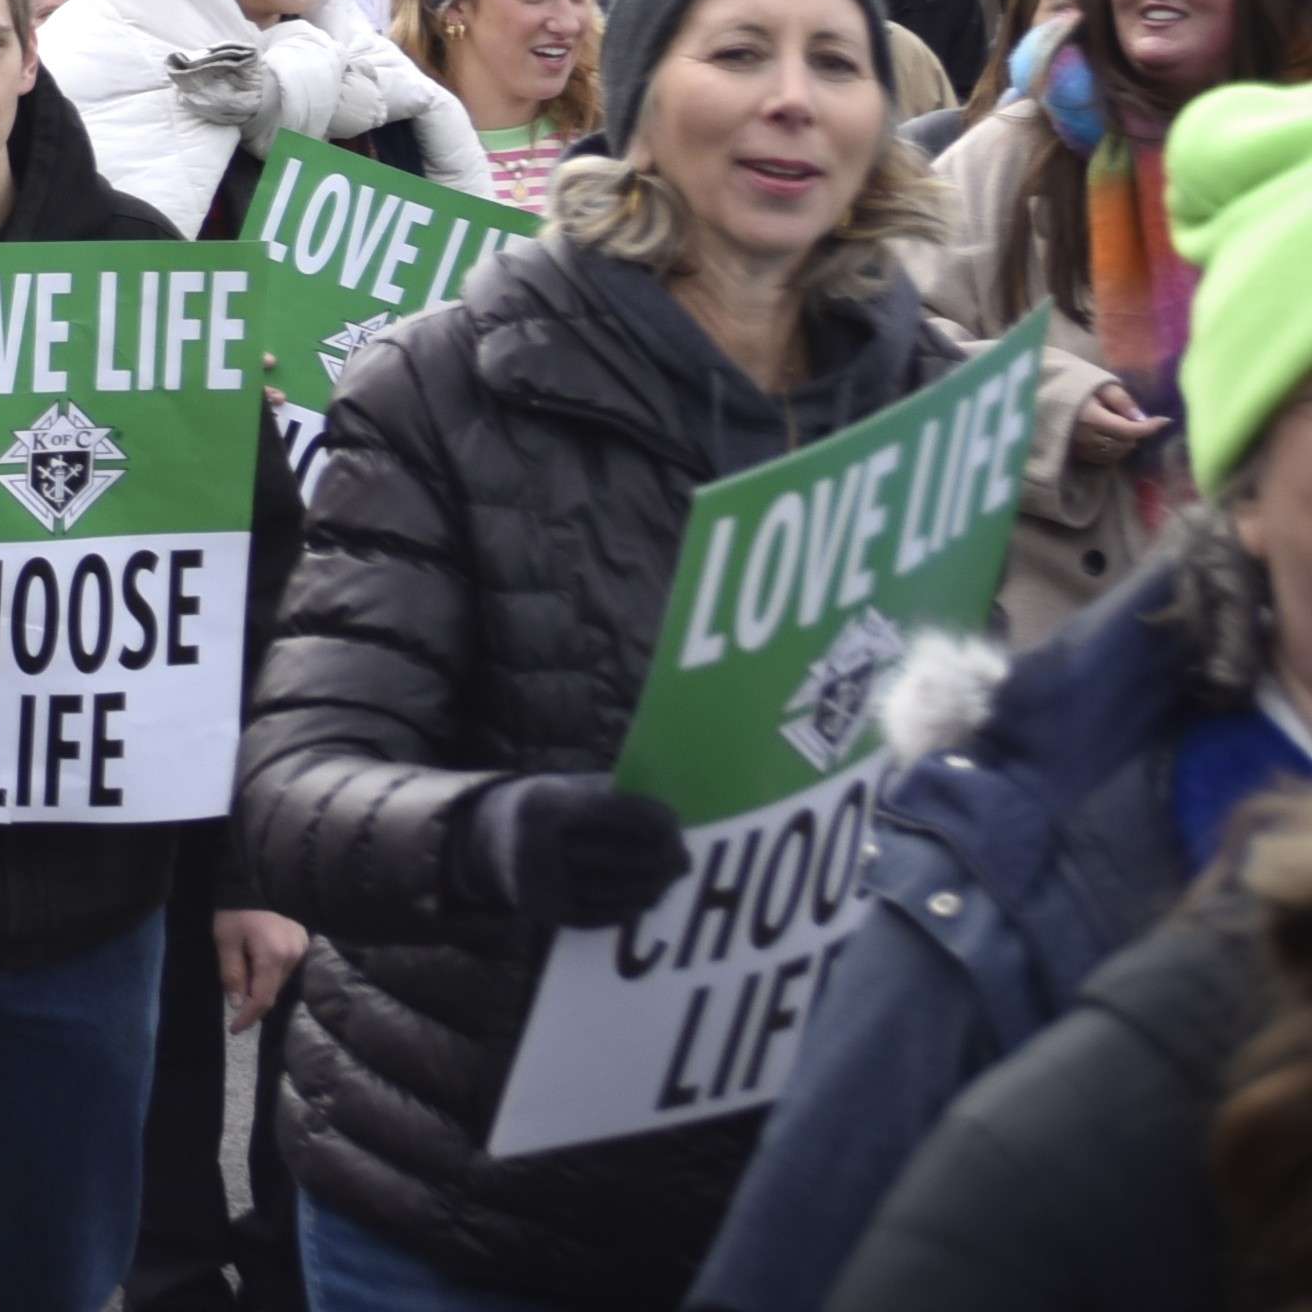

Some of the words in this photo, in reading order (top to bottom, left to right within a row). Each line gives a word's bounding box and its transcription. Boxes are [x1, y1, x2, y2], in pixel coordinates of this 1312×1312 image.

[260, 157, 434, 305] LOVE
[96, 271, 248, 391] LIFE
[33, 432, 49, 450] K
[75, 431, 92, 449] C
[680, 442, 901, 670] LOVE
[894, 348, 1035, 576] LIFE
[654, 941, 846, 1112] LIF
